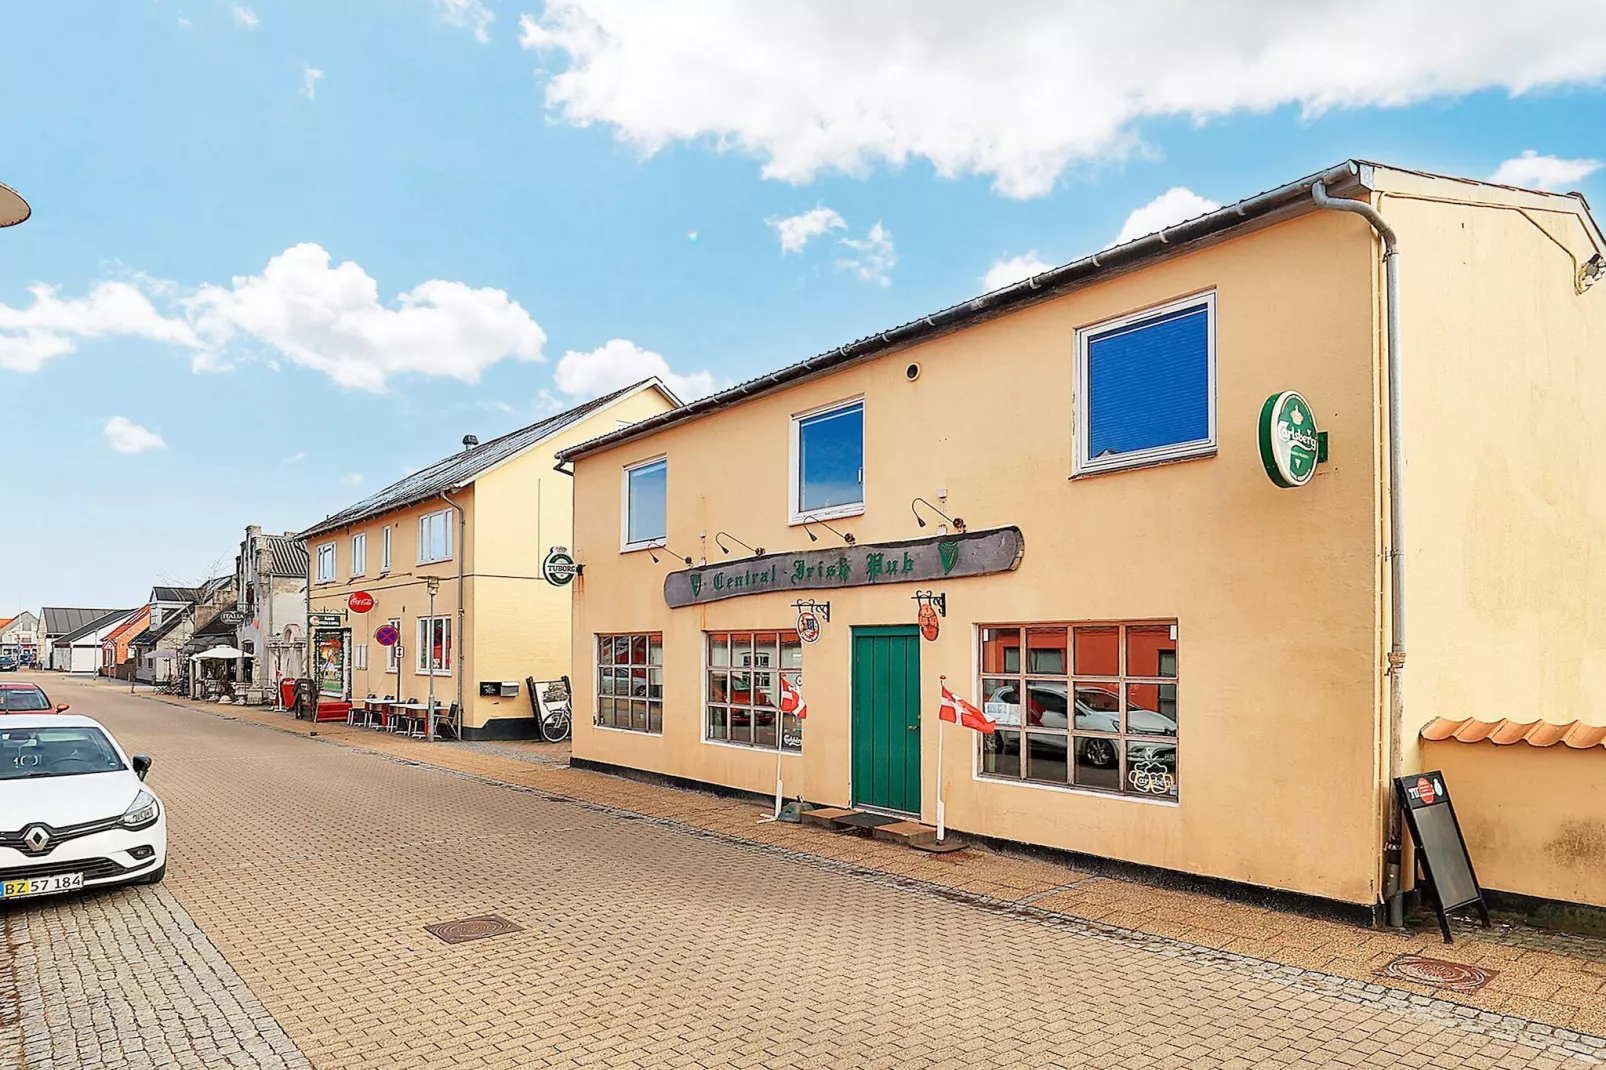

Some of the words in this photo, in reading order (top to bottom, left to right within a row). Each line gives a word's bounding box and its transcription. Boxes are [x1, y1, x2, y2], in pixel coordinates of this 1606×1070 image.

[1278, 420, 1317, 451] Carlsberg
[713, 564, 776, 591] Central
[791, 556, 851, 585] Irish
[866, 551, 915, 583] Pub
[5, 882, 26, 895] BZ
[31, 879, 49, 892] 57
[54, 875, 80, 889] 184
